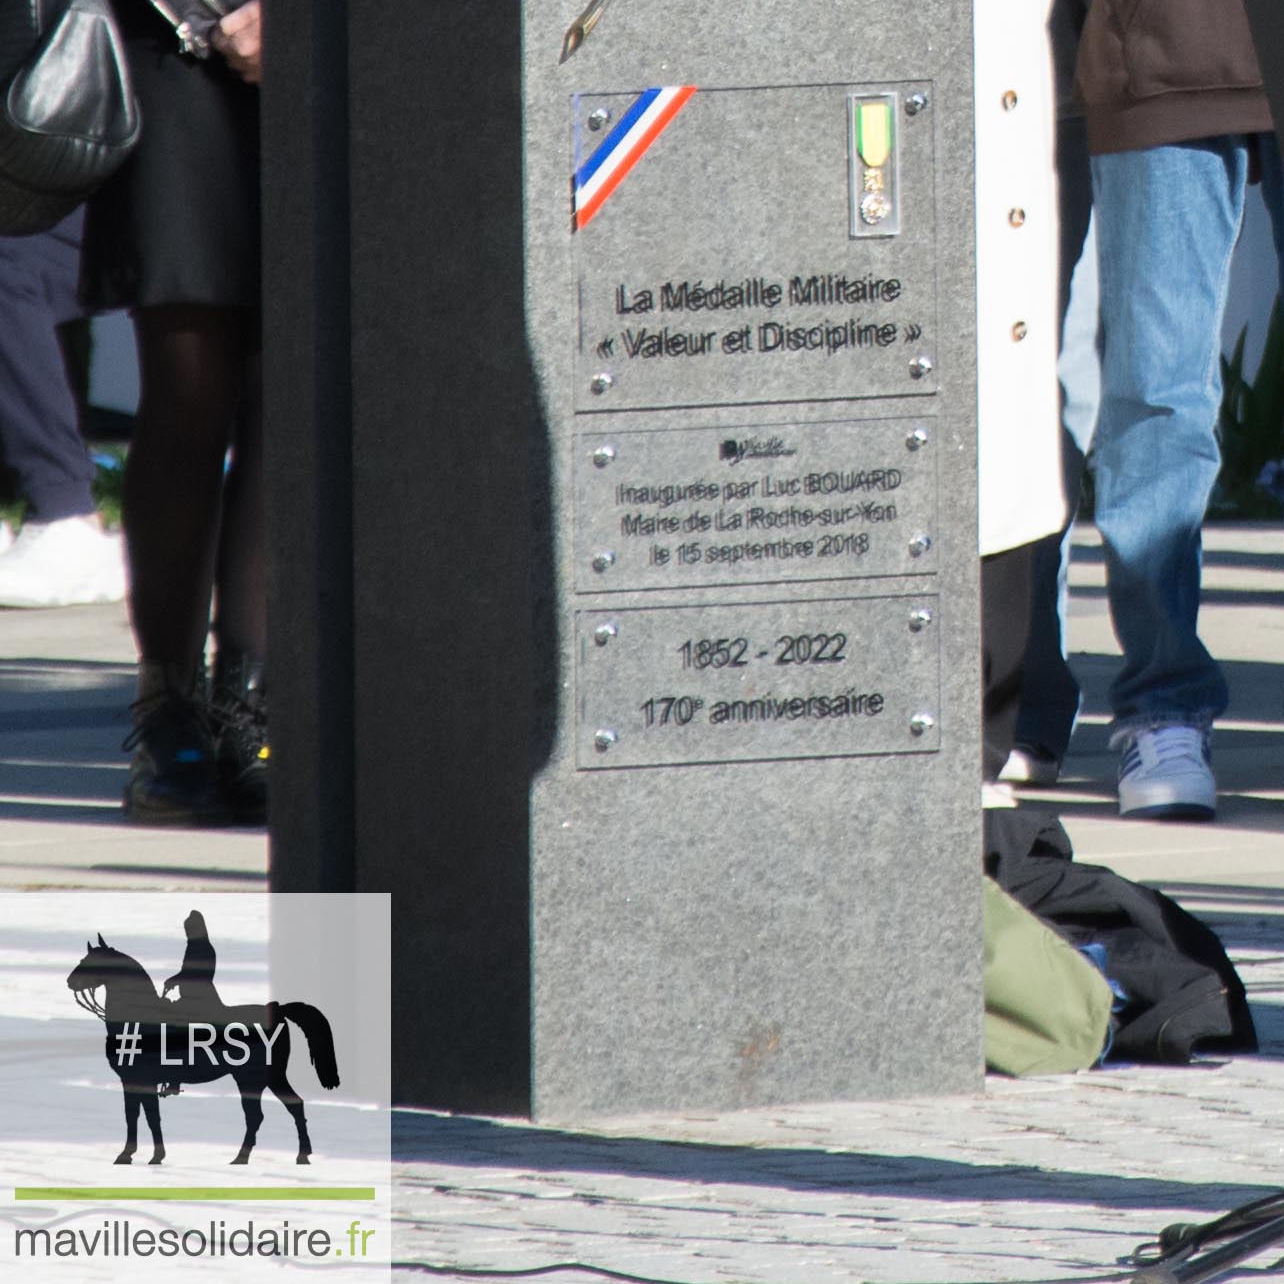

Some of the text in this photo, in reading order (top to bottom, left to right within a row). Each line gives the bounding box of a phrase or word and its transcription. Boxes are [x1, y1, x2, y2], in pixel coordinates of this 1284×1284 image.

[615, 273, 900, 314] La Médaille Militaire
[621, 326, 715, 359] Valeur
[722, 324, 752, 354] et
[758, 318, 896, 356] Discipline
[615, 469, 902, 508] Inaugurée par Luc BOUARD
[621, 500, 898, 536] Maire de La Roche-sur-Yon
[650, 544, 670, 565] le
[705, 536, 814, 566] septembre
[677, 636, 748, 669] 1852
[774, 632, 847, 666] 2022
[709, 687, 885, 725] anniversaire
